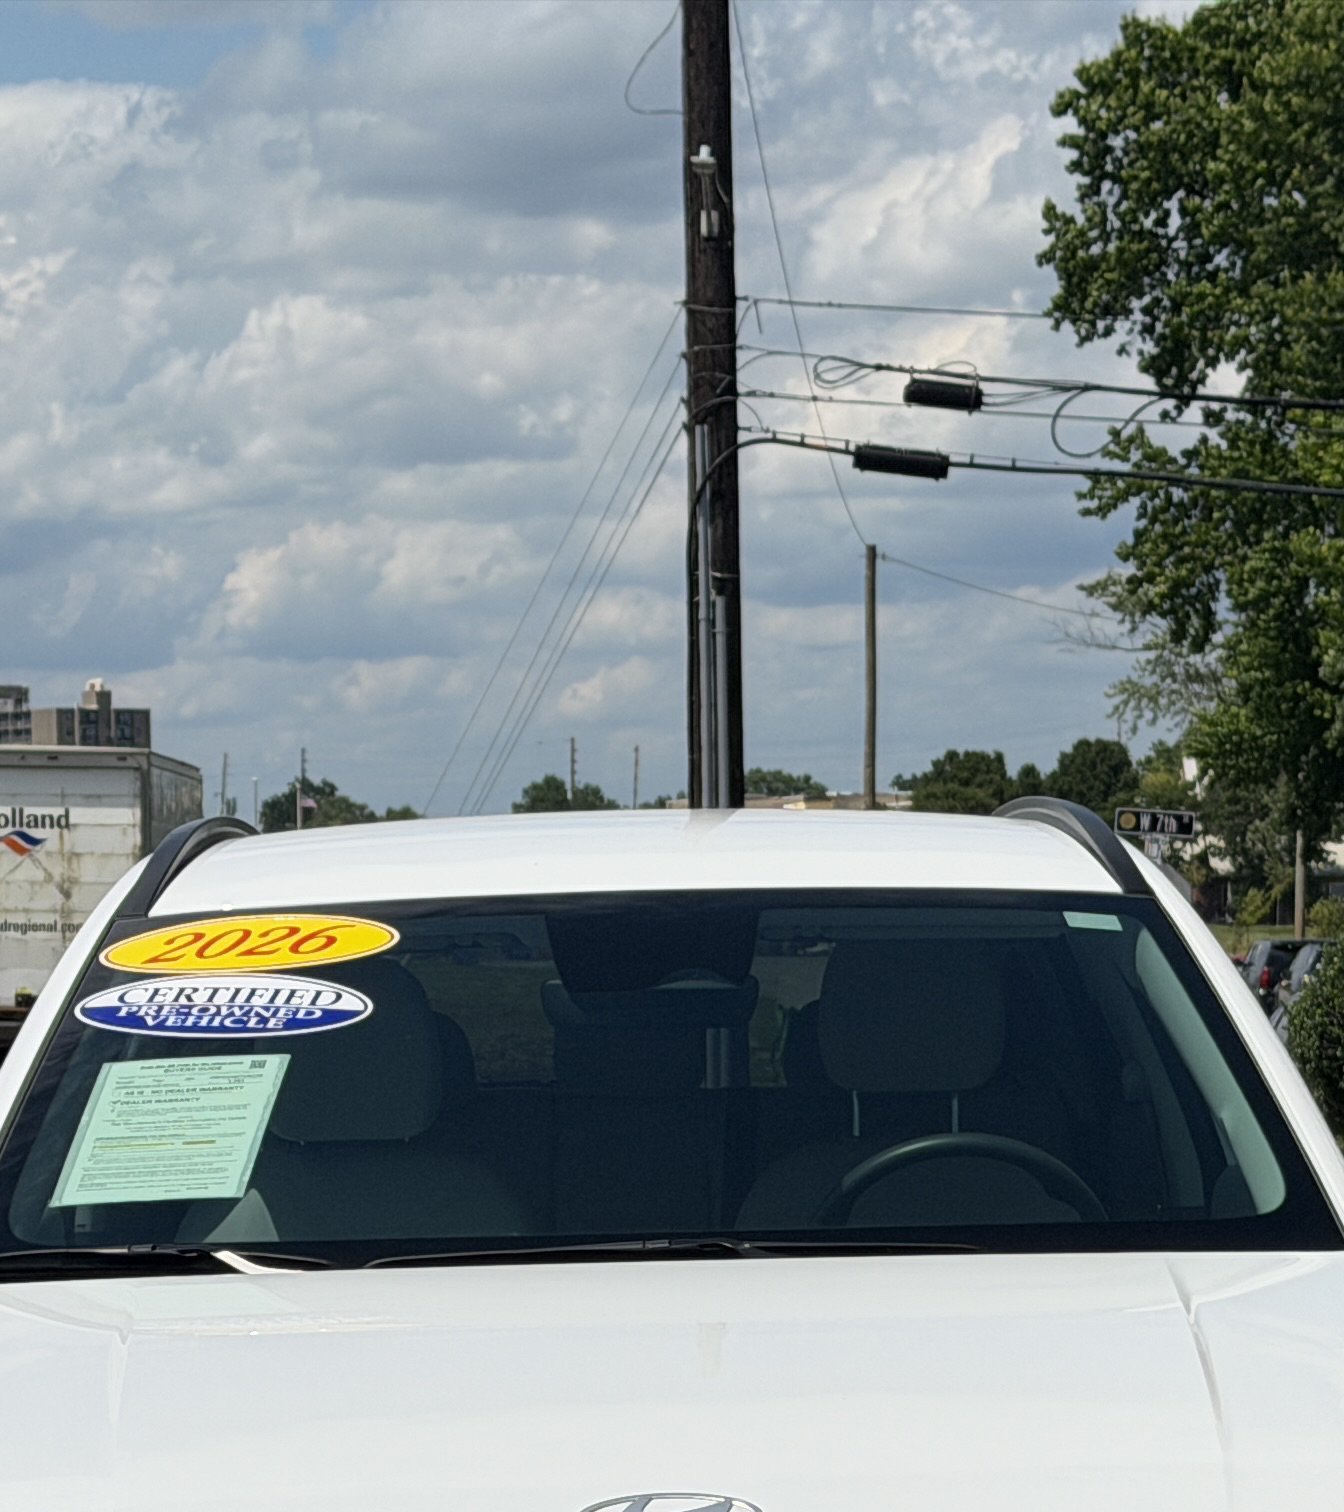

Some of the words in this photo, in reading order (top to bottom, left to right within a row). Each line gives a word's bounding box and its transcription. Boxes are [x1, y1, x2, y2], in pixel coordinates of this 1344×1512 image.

[1139, 812, 1152, 832] W
[1156, 814, 1177, 832] 7th
[141, 925, 355, 965] 2026
[117, 986, 343, 1007] CERTIFIED
[116, 1005, 323, 1020] PRE-OWNED
[143, 1015, 288, 1029] VEHICLE
